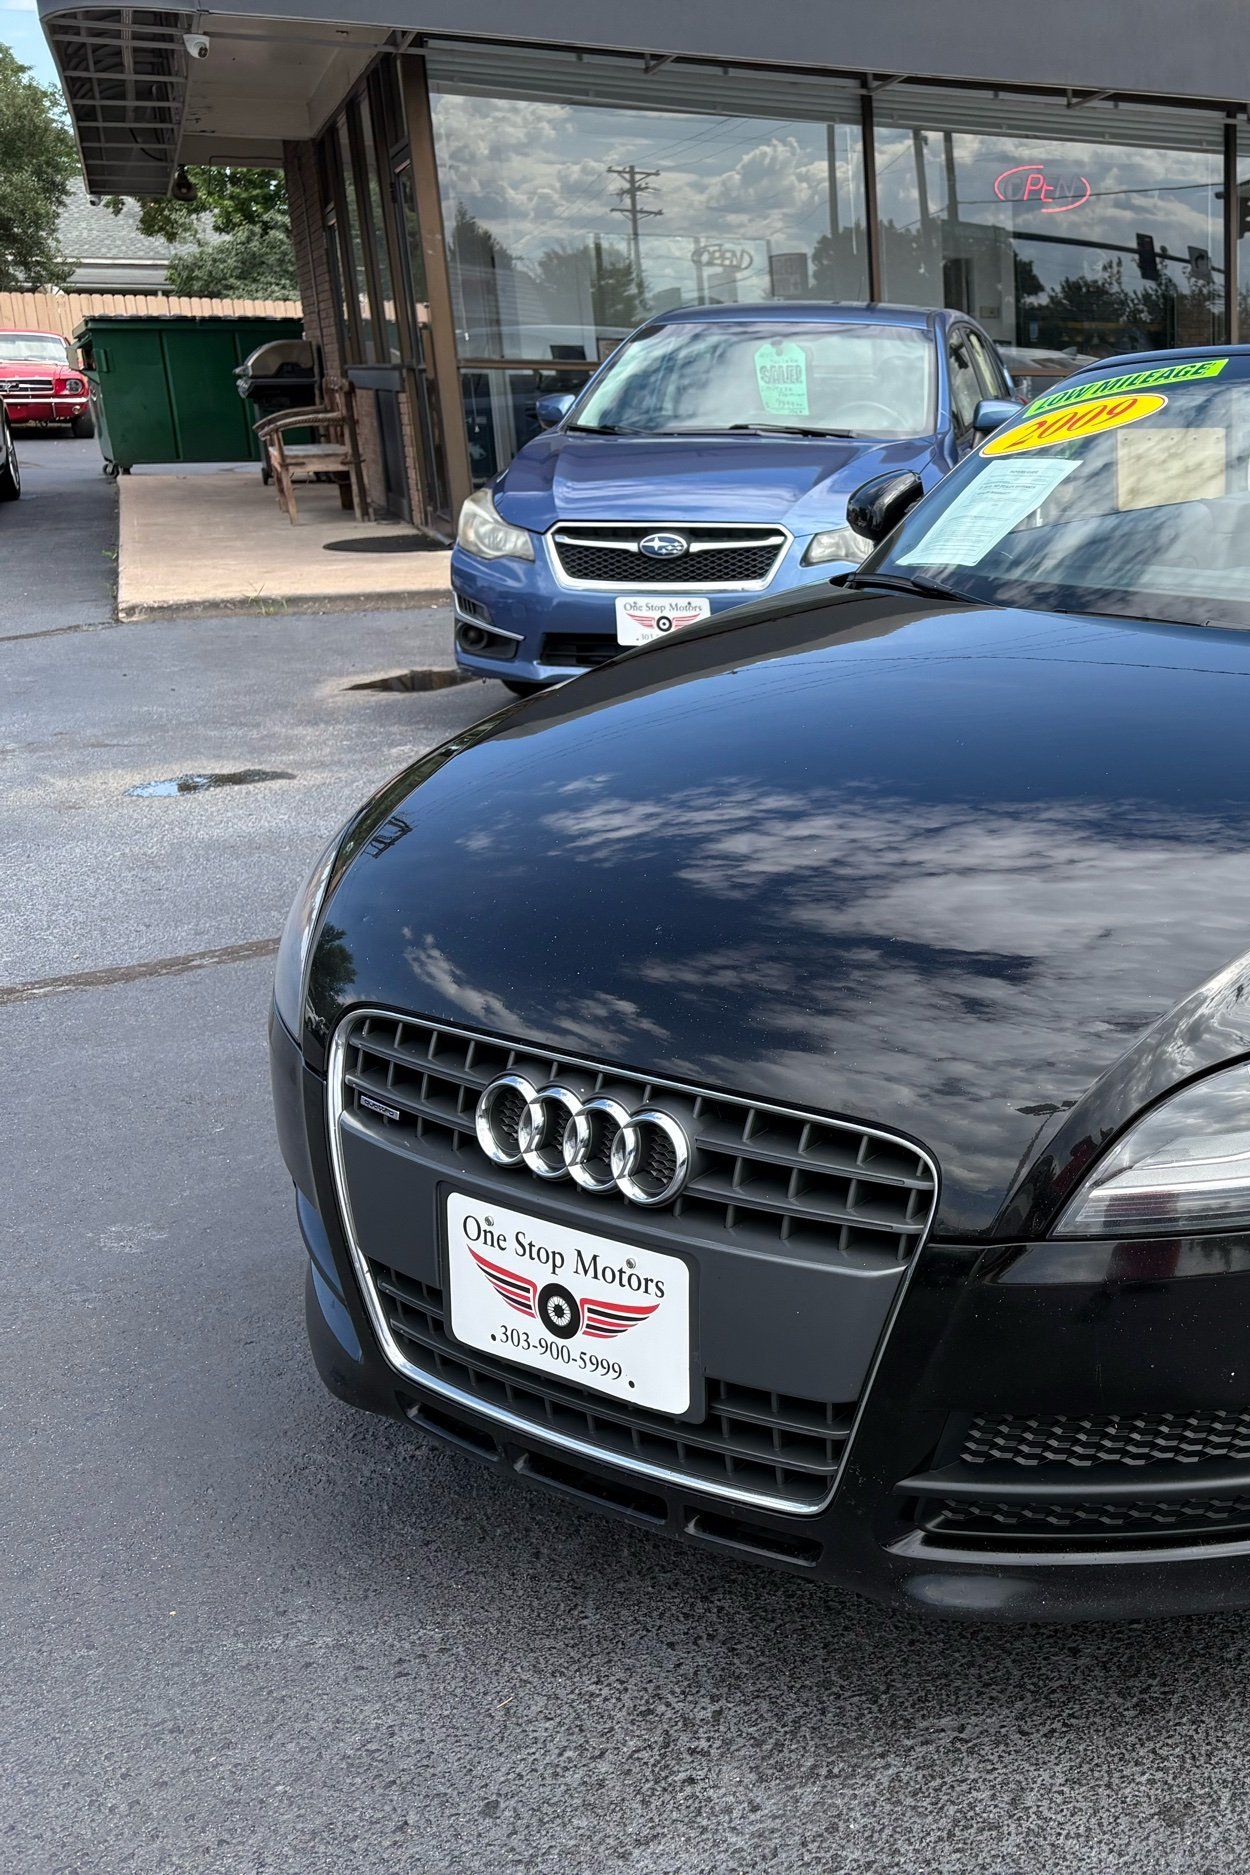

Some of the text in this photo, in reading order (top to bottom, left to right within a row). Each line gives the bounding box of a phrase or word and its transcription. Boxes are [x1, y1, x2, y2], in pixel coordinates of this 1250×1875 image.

[1036, 361, 1217, 411] LOW MILEAGE
[1003, 398, 1139, 451] 2009
[623, 602, 702, 613] One Stop Motors
[462, 1214, 665, 1299] One Stop Motors
[499, 1324, 623, 1381] 303-900-5999
